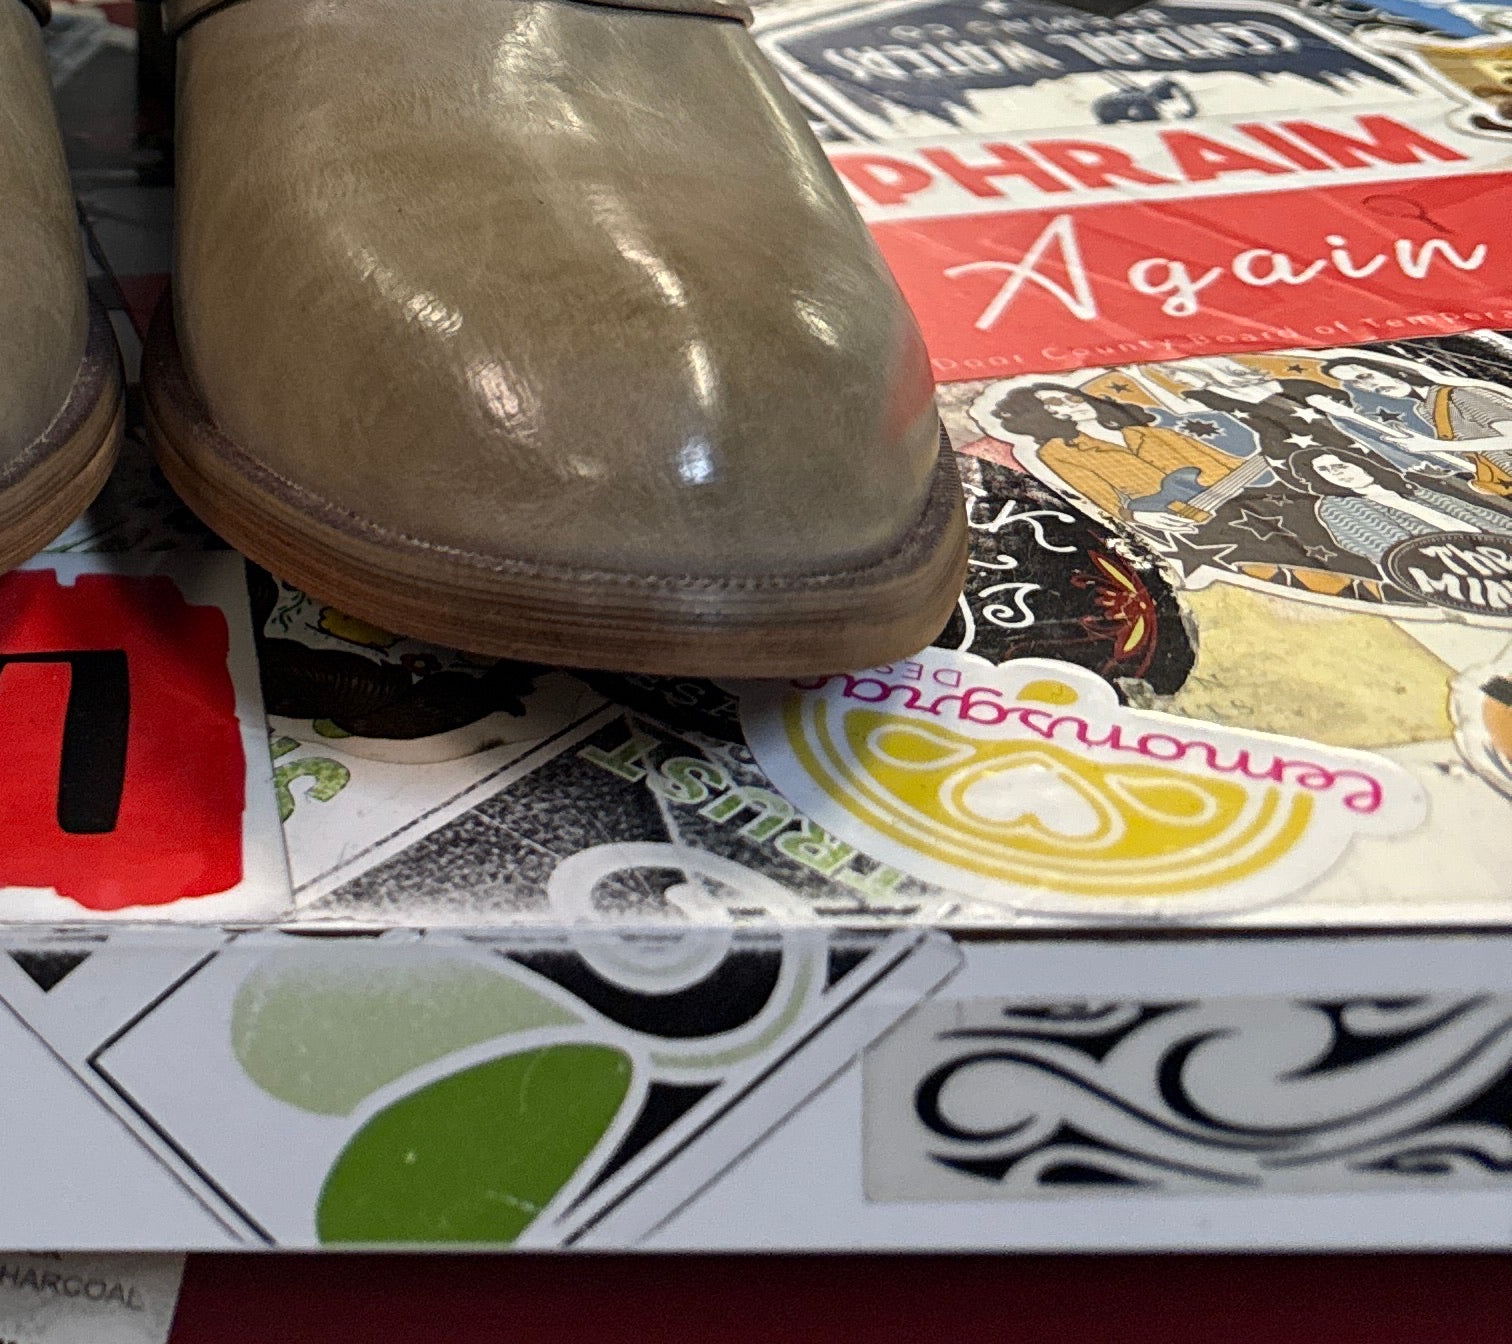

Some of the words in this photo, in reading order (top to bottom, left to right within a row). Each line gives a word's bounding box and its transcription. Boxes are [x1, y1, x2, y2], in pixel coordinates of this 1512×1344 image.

[823, 40, 1064, 83] WATERS
[1044, 18, 1302, 69] CENTRAL
[835, 113, 1468, 208] PHRAIM
[945, 213, 1488, 331] Again
[932, 352, 1022, 372] Door
[1041, 336, 1173, 364] County
[1193, 327, 1296, 345] Board
[1318, 320, 1346, 336] of
[576, 734, 908, 904] TRUST
